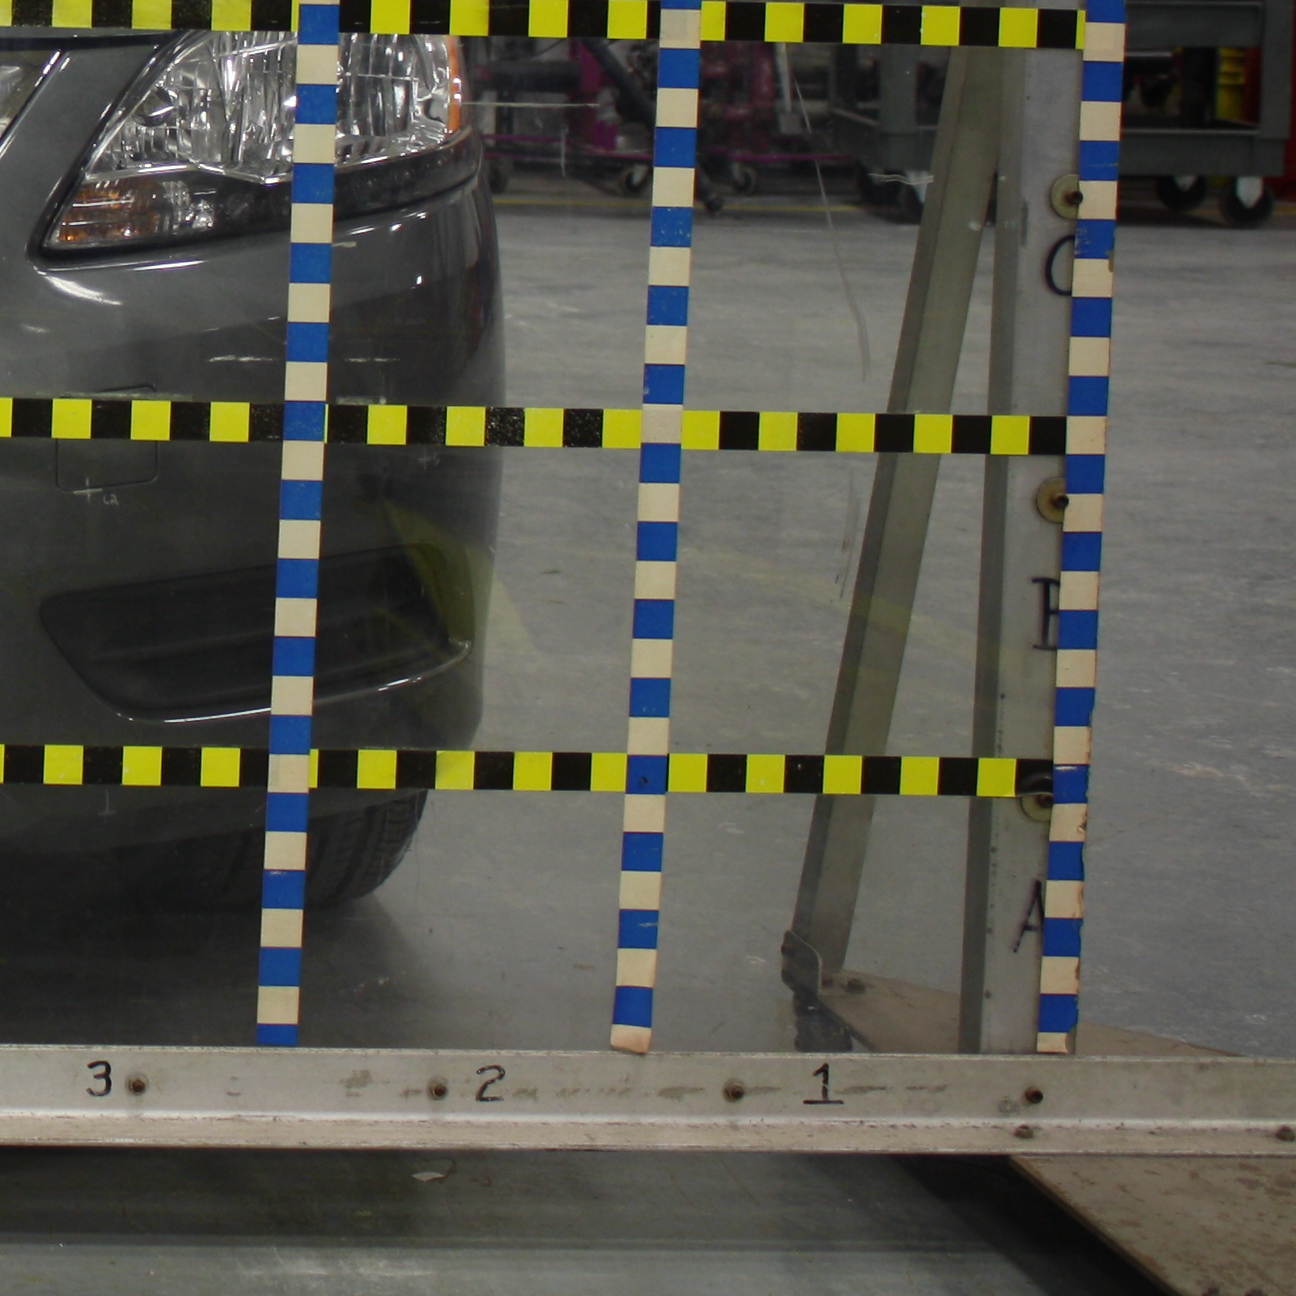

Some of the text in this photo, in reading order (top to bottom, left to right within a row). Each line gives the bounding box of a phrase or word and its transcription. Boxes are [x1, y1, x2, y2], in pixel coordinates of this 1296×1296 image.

[86, 1060, 112, 1097] 3
[476, 1065, 506, 1102] 2
[803, 1062, 844, 1104] 1
